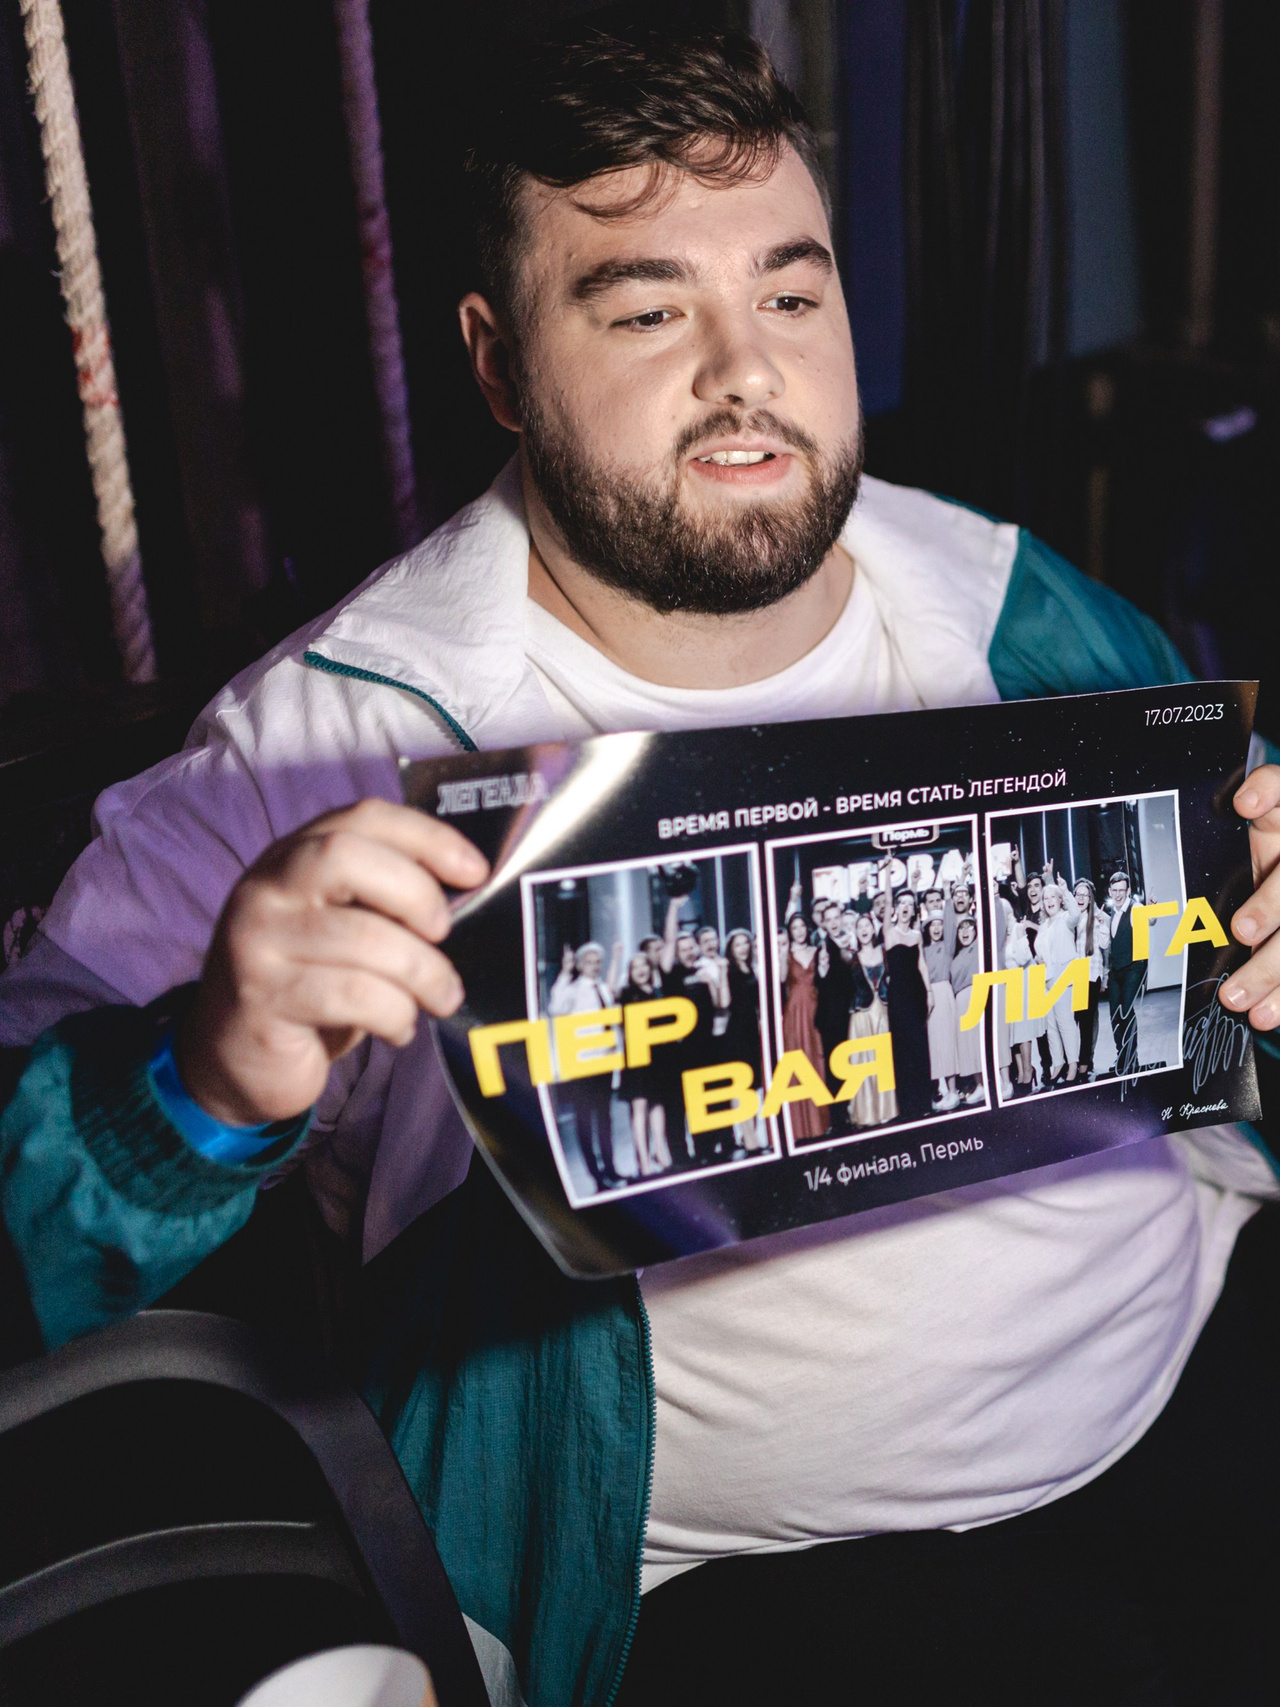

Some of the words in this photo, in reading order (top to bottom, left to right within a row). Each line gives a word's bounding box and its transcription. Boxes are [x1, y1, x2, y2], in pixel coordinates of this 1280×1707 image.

[1144, 703, 1225, 727] 17.07.2023
[657, 807, 730, 839] ВРЕМЯ
[734, 797, 819, 829] ПЕРВОЙ
[835, 788, 902, 815] ВРЕМЯ
[907, 783, 964, 806] СТАТЬ
[968, 768, 1067, 798] ЛЕГЕНДОЙ
[881, 827, 930, 844] Пермь
[1131, 896, 1229, 962] ГА
[959, 957, 1090, 1032] ЛИ
[468, 995, 697, 1098] ПЕР
[681, 1032, 897, 1135] ВАЯ
[803, 1166, 833, 1193] 1/4
[836, 1149, 918, 1184] финала,
[919, 1134, 984, 1162] Пермь
